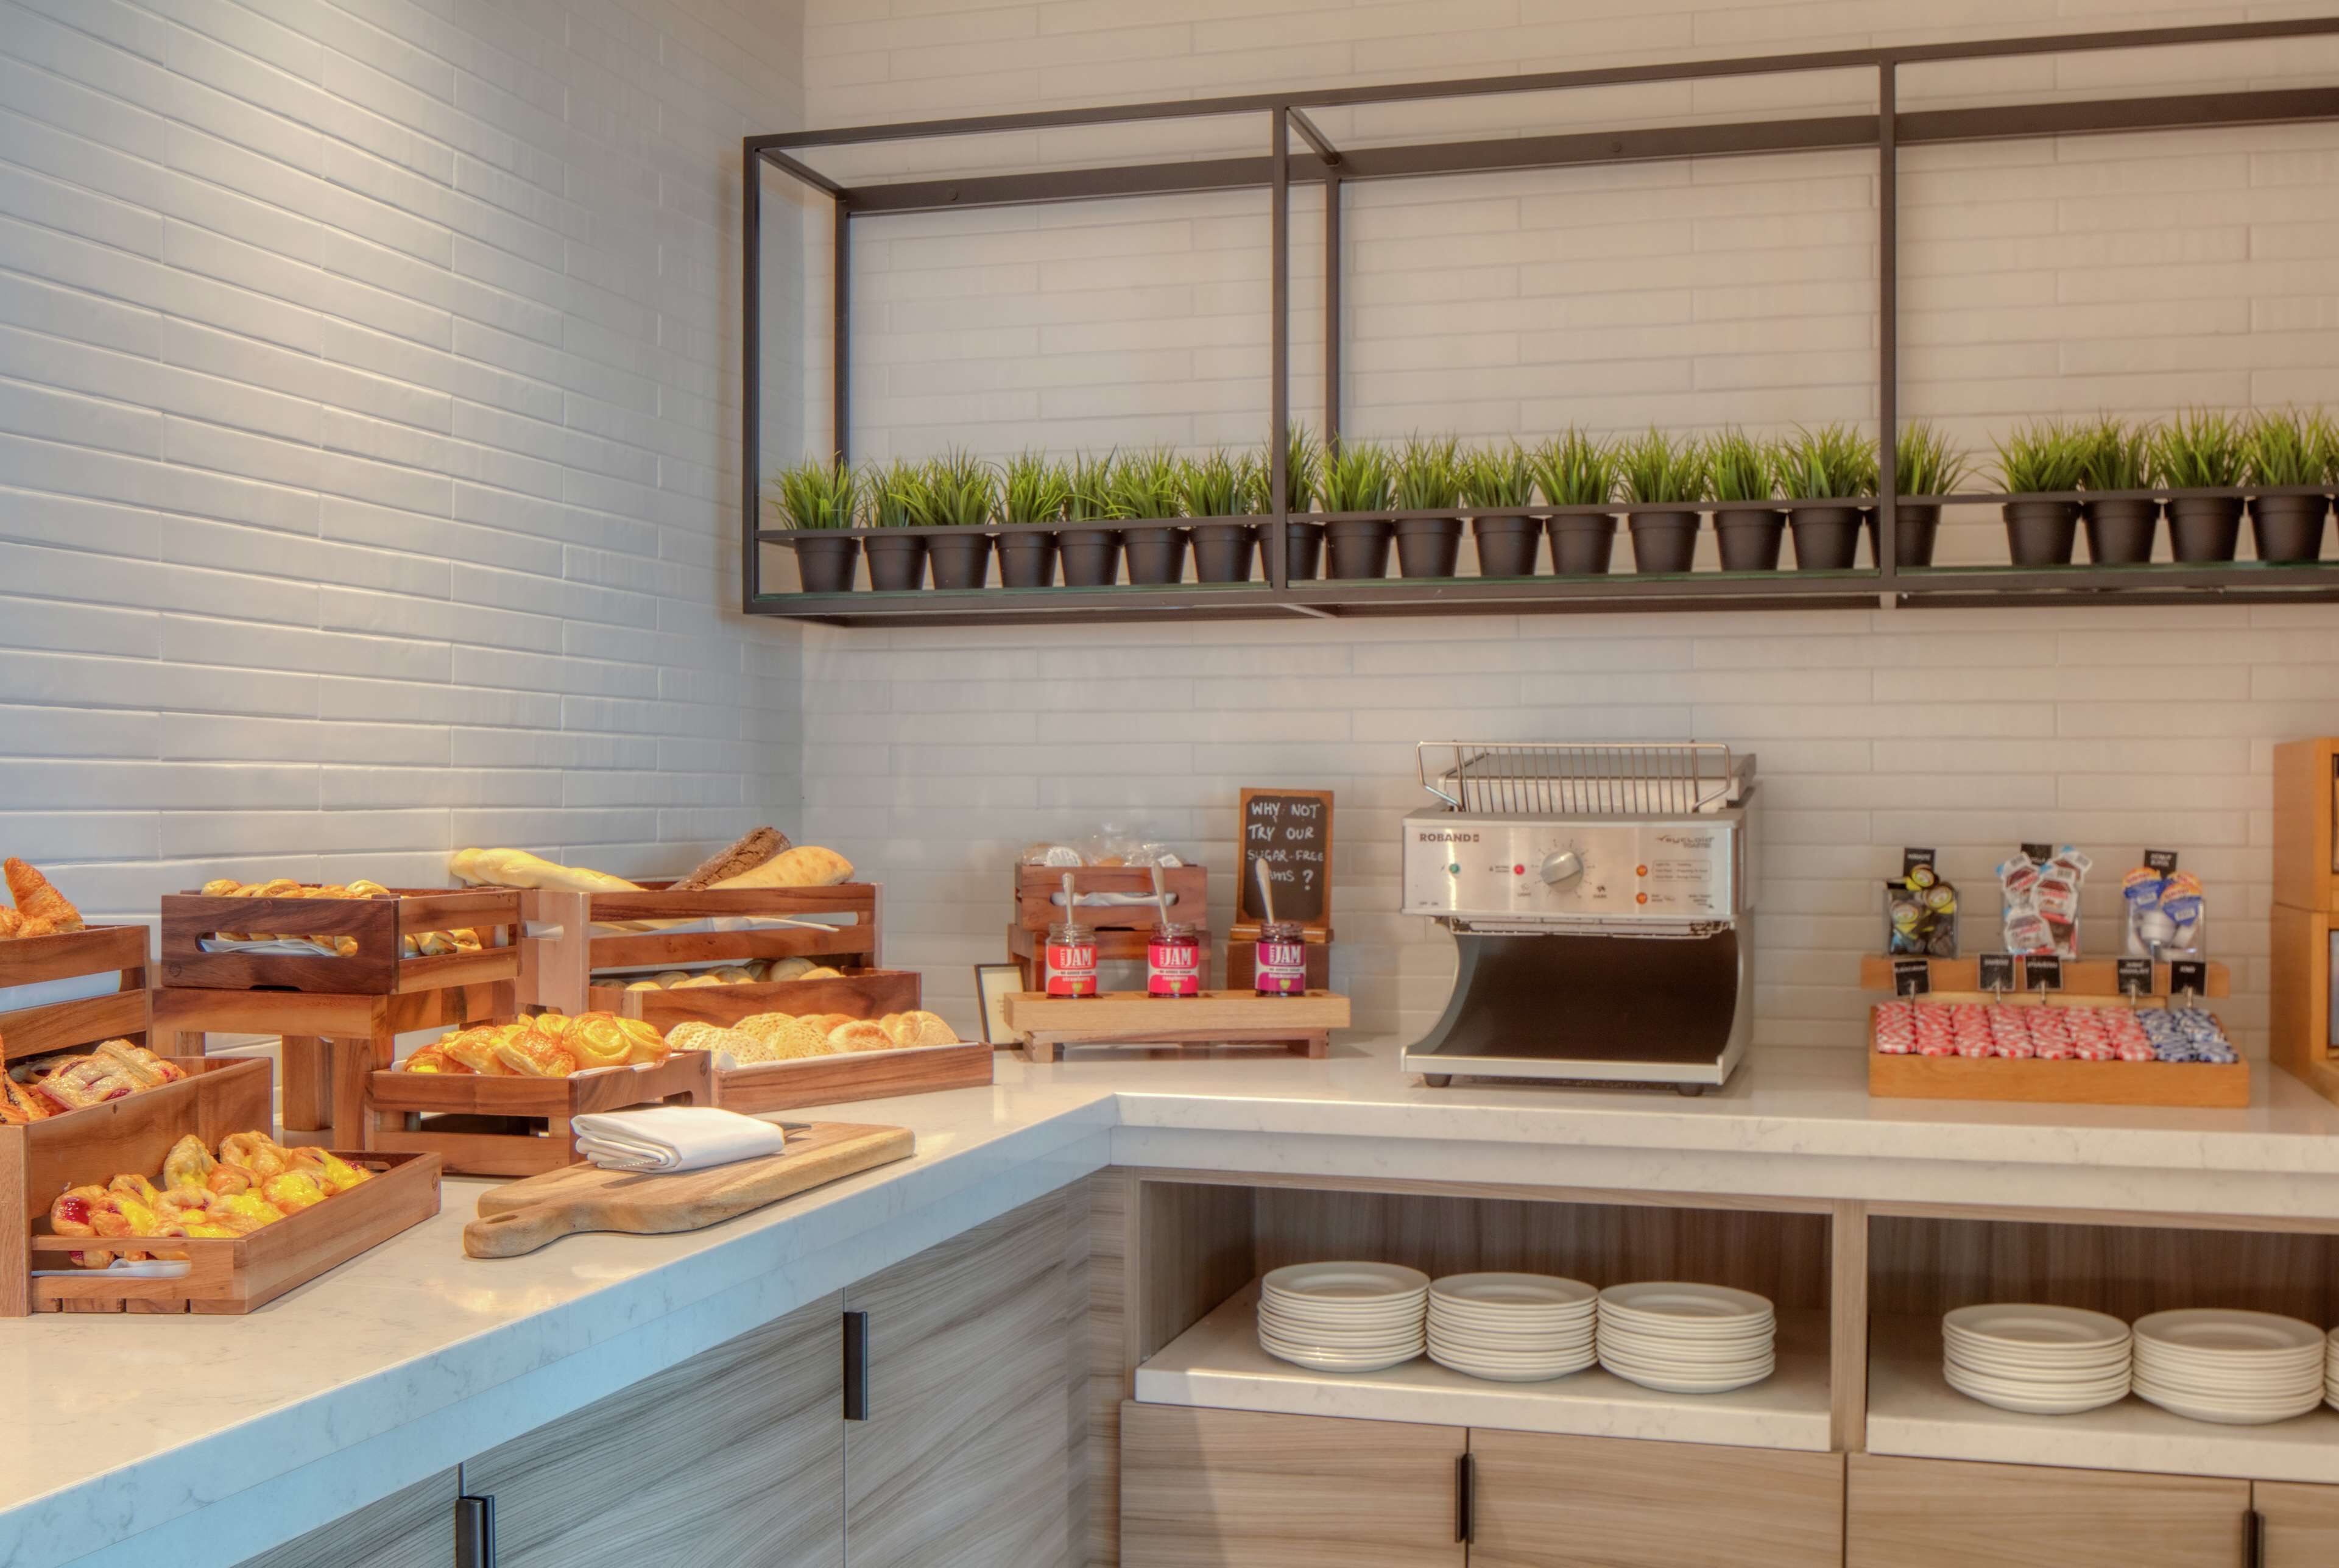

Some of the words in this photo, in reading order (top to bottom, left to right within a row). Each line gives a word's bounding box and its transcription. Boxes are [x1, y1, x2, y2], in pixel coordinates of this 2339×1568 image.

[1251, 802, 1280, 818] WHY
[1291, 803, 1321, 819] NOT
[1247, 823, 1275, 842] TRY
[1286, 826, 1314, 840] OUR
[1419, 833, 1472, 842] ROBAND
[1065, 948, 1092, 966] JAM
[1165, 947, 1191, 966] JAM
[1274, 945, 1302, 964] JAM
